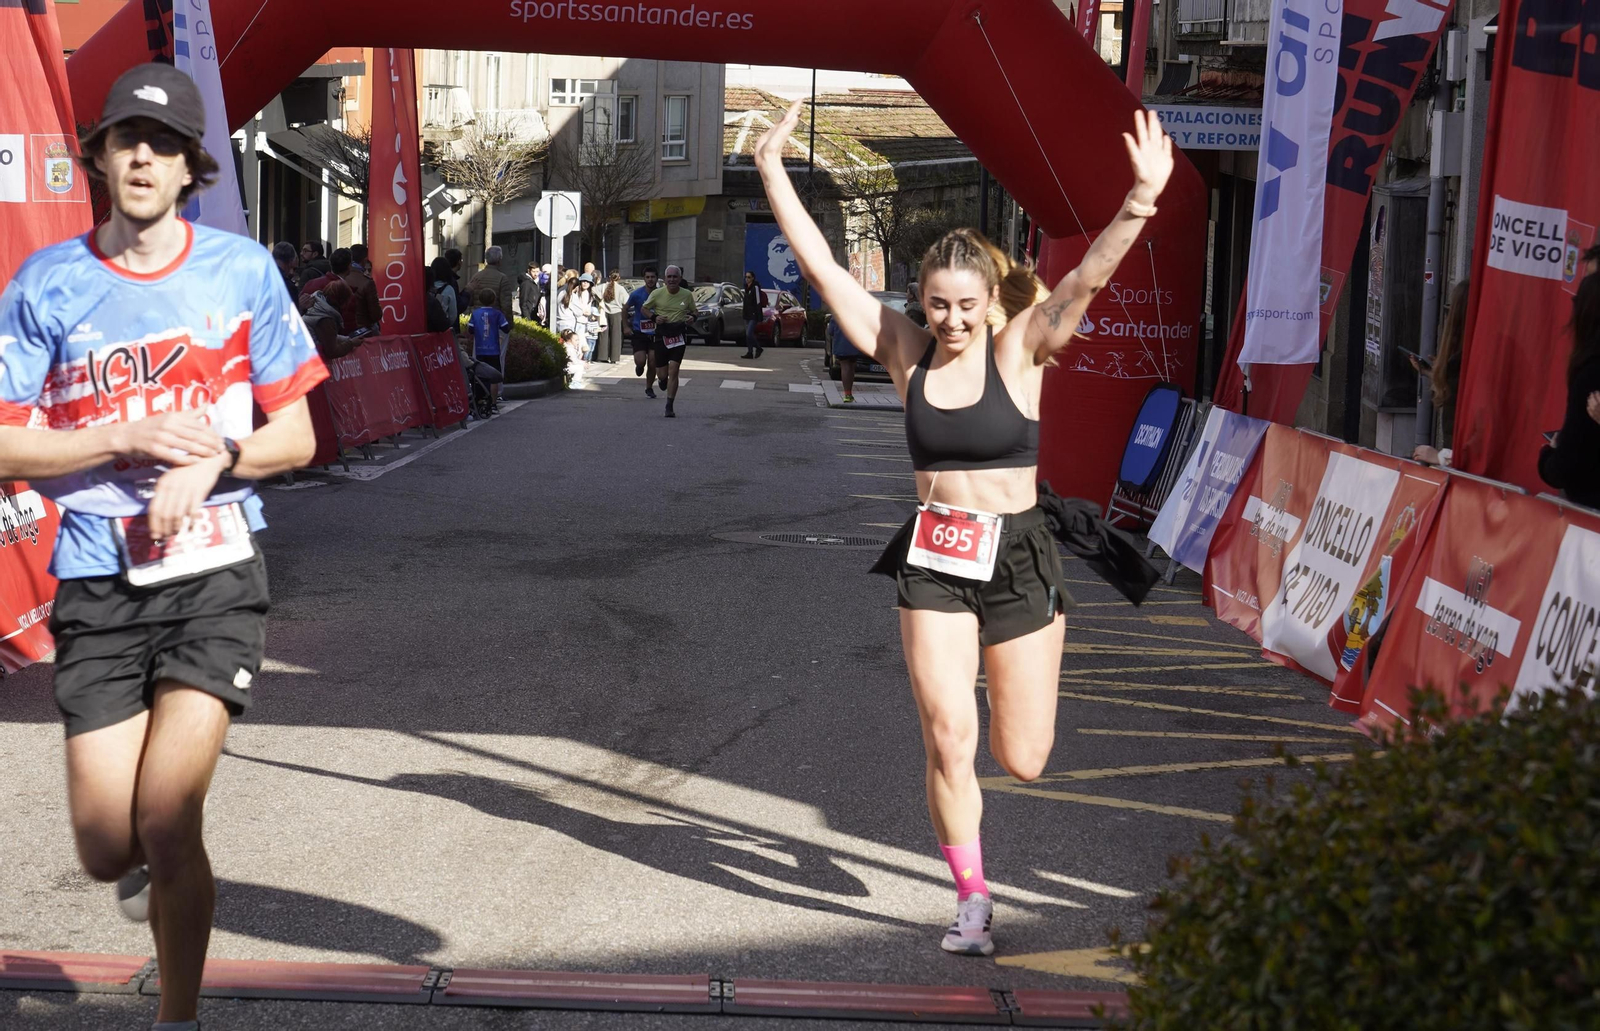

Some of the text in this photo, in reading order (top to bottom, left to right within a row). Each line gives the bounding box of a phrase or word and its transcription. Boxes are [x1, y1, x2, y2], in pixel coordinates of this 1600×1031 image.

[510, 0, 754, 30] sportssantander.es
[1182, 132, 1192, 143] Y
[1512, 239, 1562, 263] VIGO
[1109, 283, 1173, 305] Sports
[1099, 317, 1193, 339] Santander
[932, 523, 974, 552] 695
[1304, 496, 1375, 567] ONCELLO
[1292, 571, 1340, 630] VIGO
